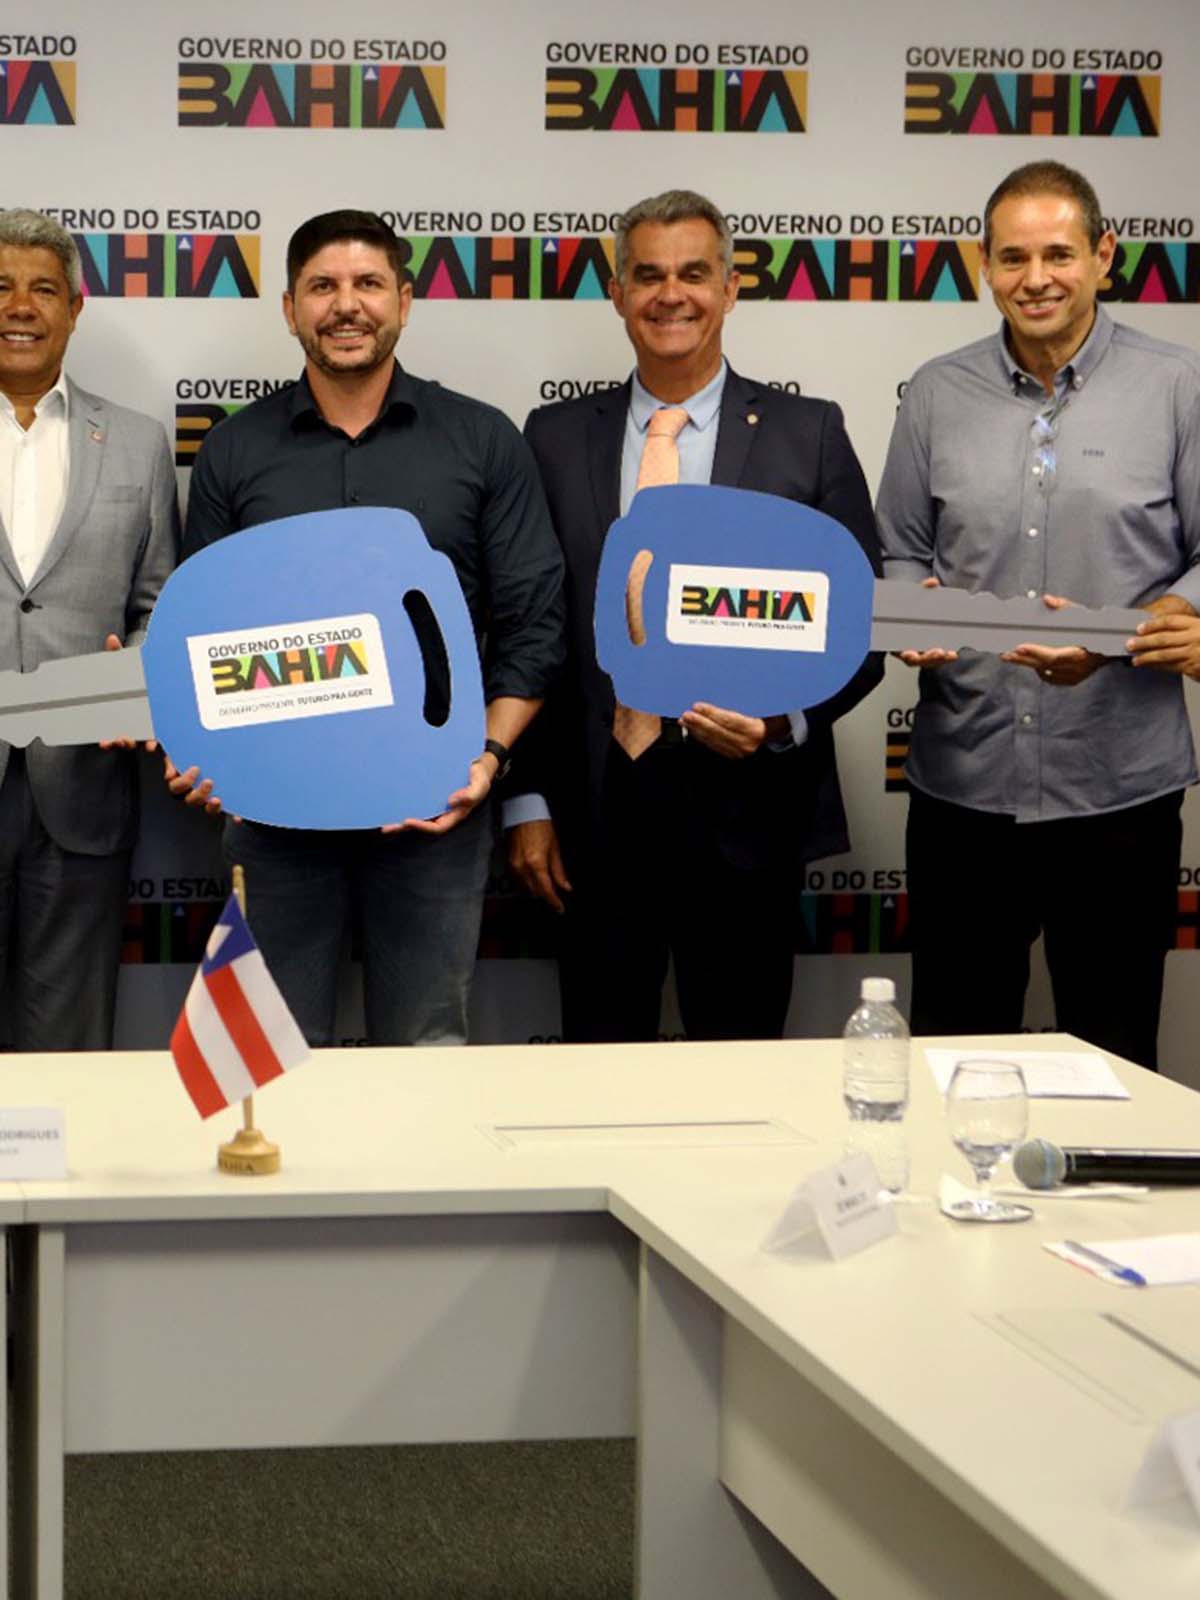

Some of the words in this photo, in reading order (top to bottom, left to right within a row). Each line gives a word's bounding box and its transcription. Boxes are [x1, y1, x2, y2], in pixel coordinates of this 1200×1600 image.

[178, 37, 302, 59] GOVERNO
[311, 39, 345, 60] DO
[353, 40, 446, 61] ESTADO
[546, 42, 667, 64] GOVERNO
[675, 44, 709, 64] DO
[717, 44, 809, 65] ESTADO
[906, 47, 1024, 68] GOVERNO
[1032, 49, 1066, 69] DO
[1073, 49, 1162, 70] ESTADO
[177, 62, 446, 129] BAHIA
[545, 67, 809, 133] BAHIA
[904, 71, 1161, 137] BAHIA
[124, 209, 159, 230] DO
[167, 210, 261, 231] ESTADO
[491, 212, 525, 233] DO
[725, 213, 842, 235] GOVERNO
[850, 215, 884, 235] DO
[892, 216, 981, 236] ESTADO
[732, 238, 981, 302] BAHIA
[681, 584, 816, 623] BAHIA
[207, 638, 280, 659] GOVERNO
[283, 635, 304, 649] DO
[308, 626, 362, 646] ESTADO
[210, 640, 369, 695] BAHIA
[832, 870, 865, 891] DO
